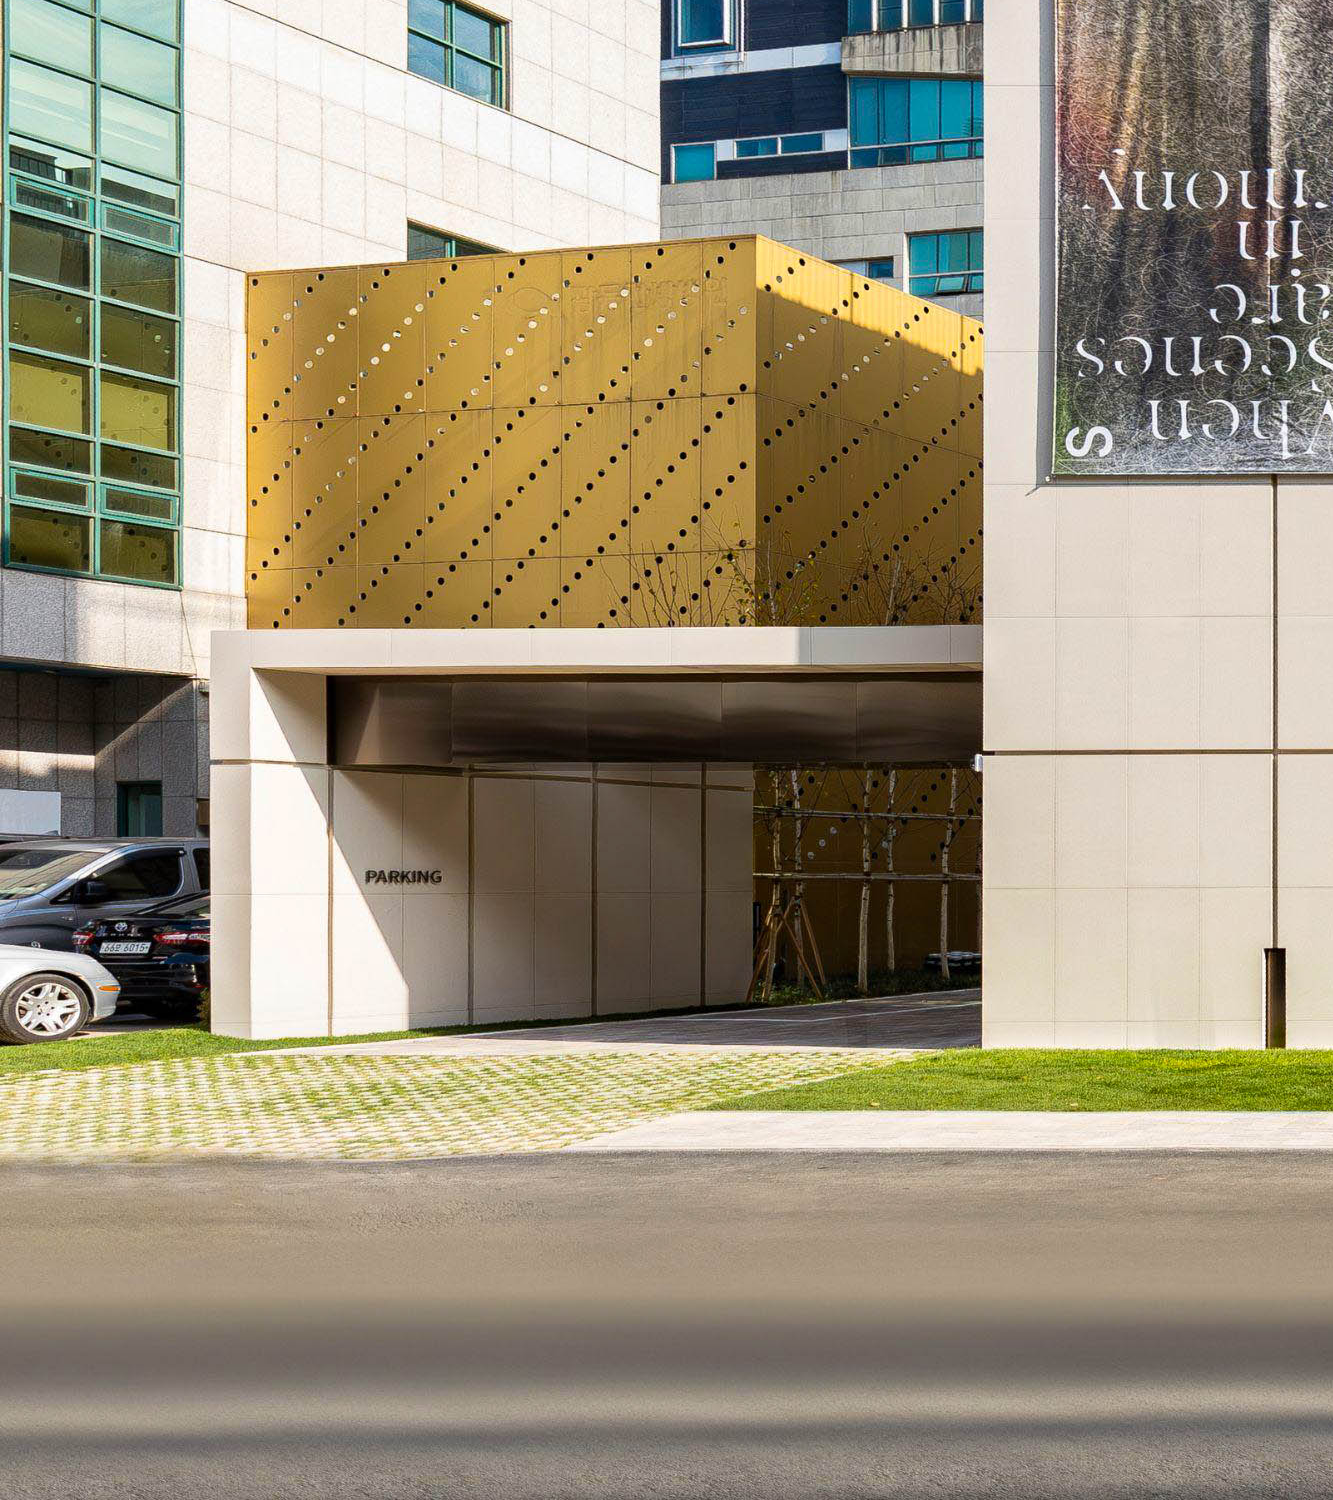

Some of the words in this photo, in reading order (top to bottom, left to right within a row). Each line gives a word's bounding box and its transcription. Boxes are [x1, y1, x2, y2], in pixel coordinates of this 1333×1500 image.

[1237, 219, 1304, 278] in
[1208, 283, 1332, 325] are
[1065, 426, 1114, 458] S
[365, 869, 443, 885] PARKING
